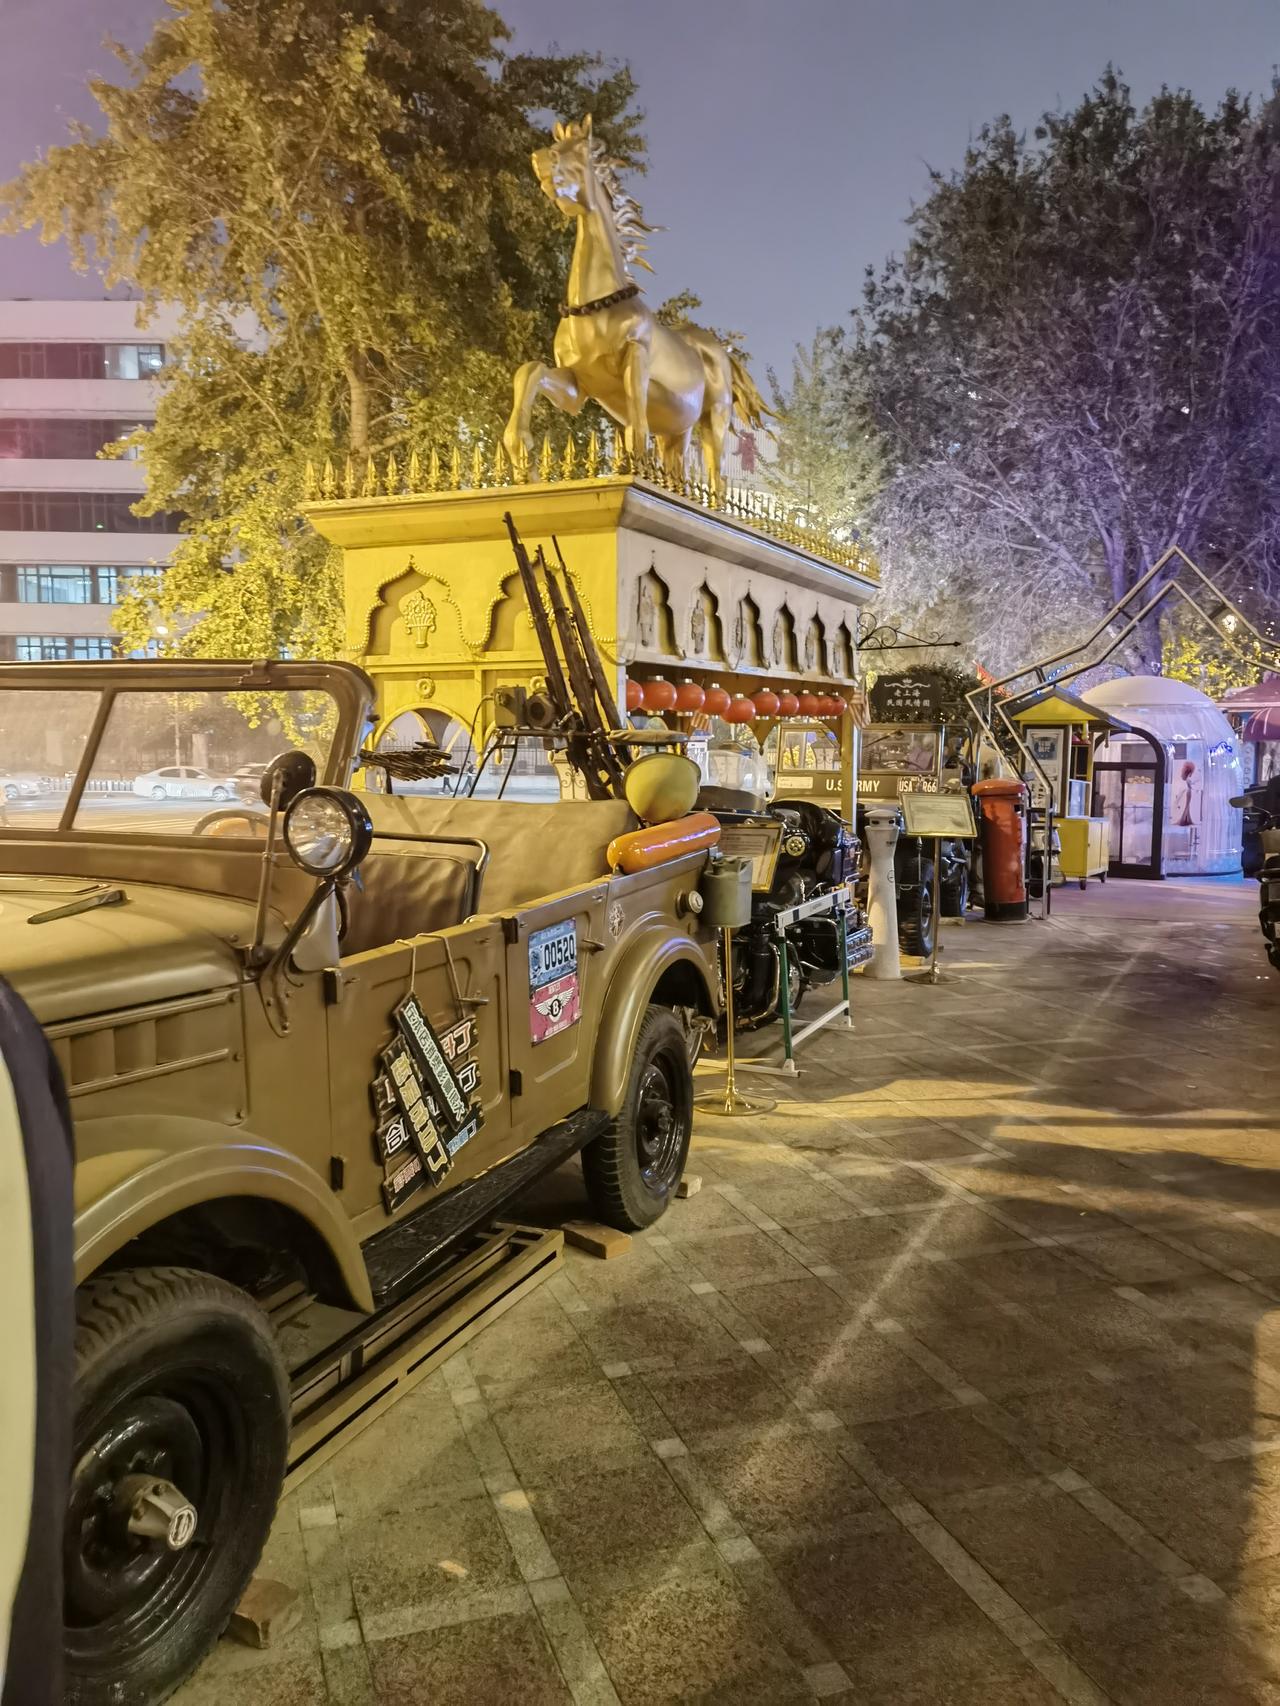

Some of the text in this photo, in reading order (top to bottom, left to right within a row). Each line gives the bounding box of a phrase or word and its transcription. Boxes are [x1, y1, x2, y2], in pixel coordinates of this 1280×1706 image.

[894, 688, 921, 698] 老上海
[898, 780, 913, 793] USA
[543, 934, 575, 971] 00520
